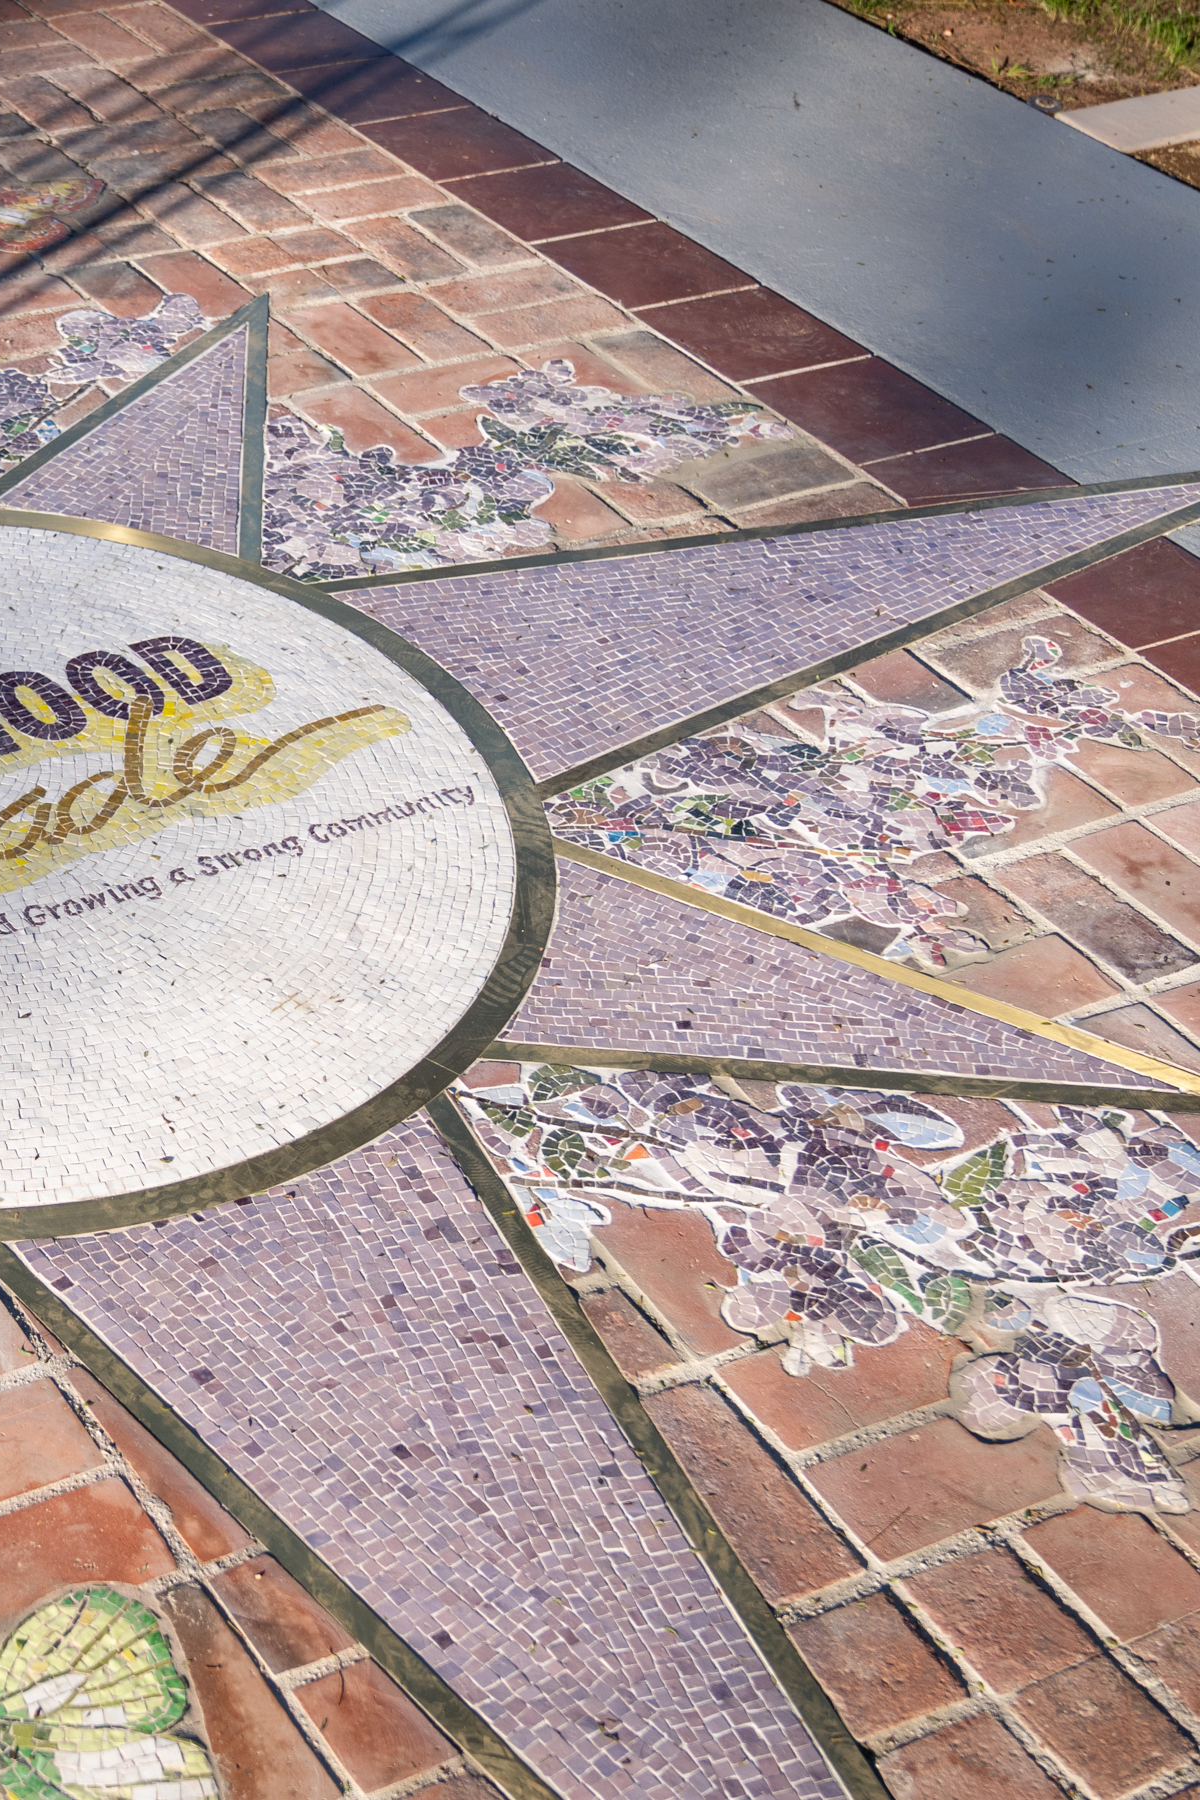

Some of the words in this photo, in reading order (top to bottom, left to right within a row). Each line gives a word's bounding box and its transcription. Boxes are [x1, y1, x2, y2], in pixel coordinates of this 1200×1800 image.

[23, 875, 163, 927] Growing
[168, 866, 196, 884] a
[197, 835, 304, 877] Strong
[307, 784, 476, 844] Community
